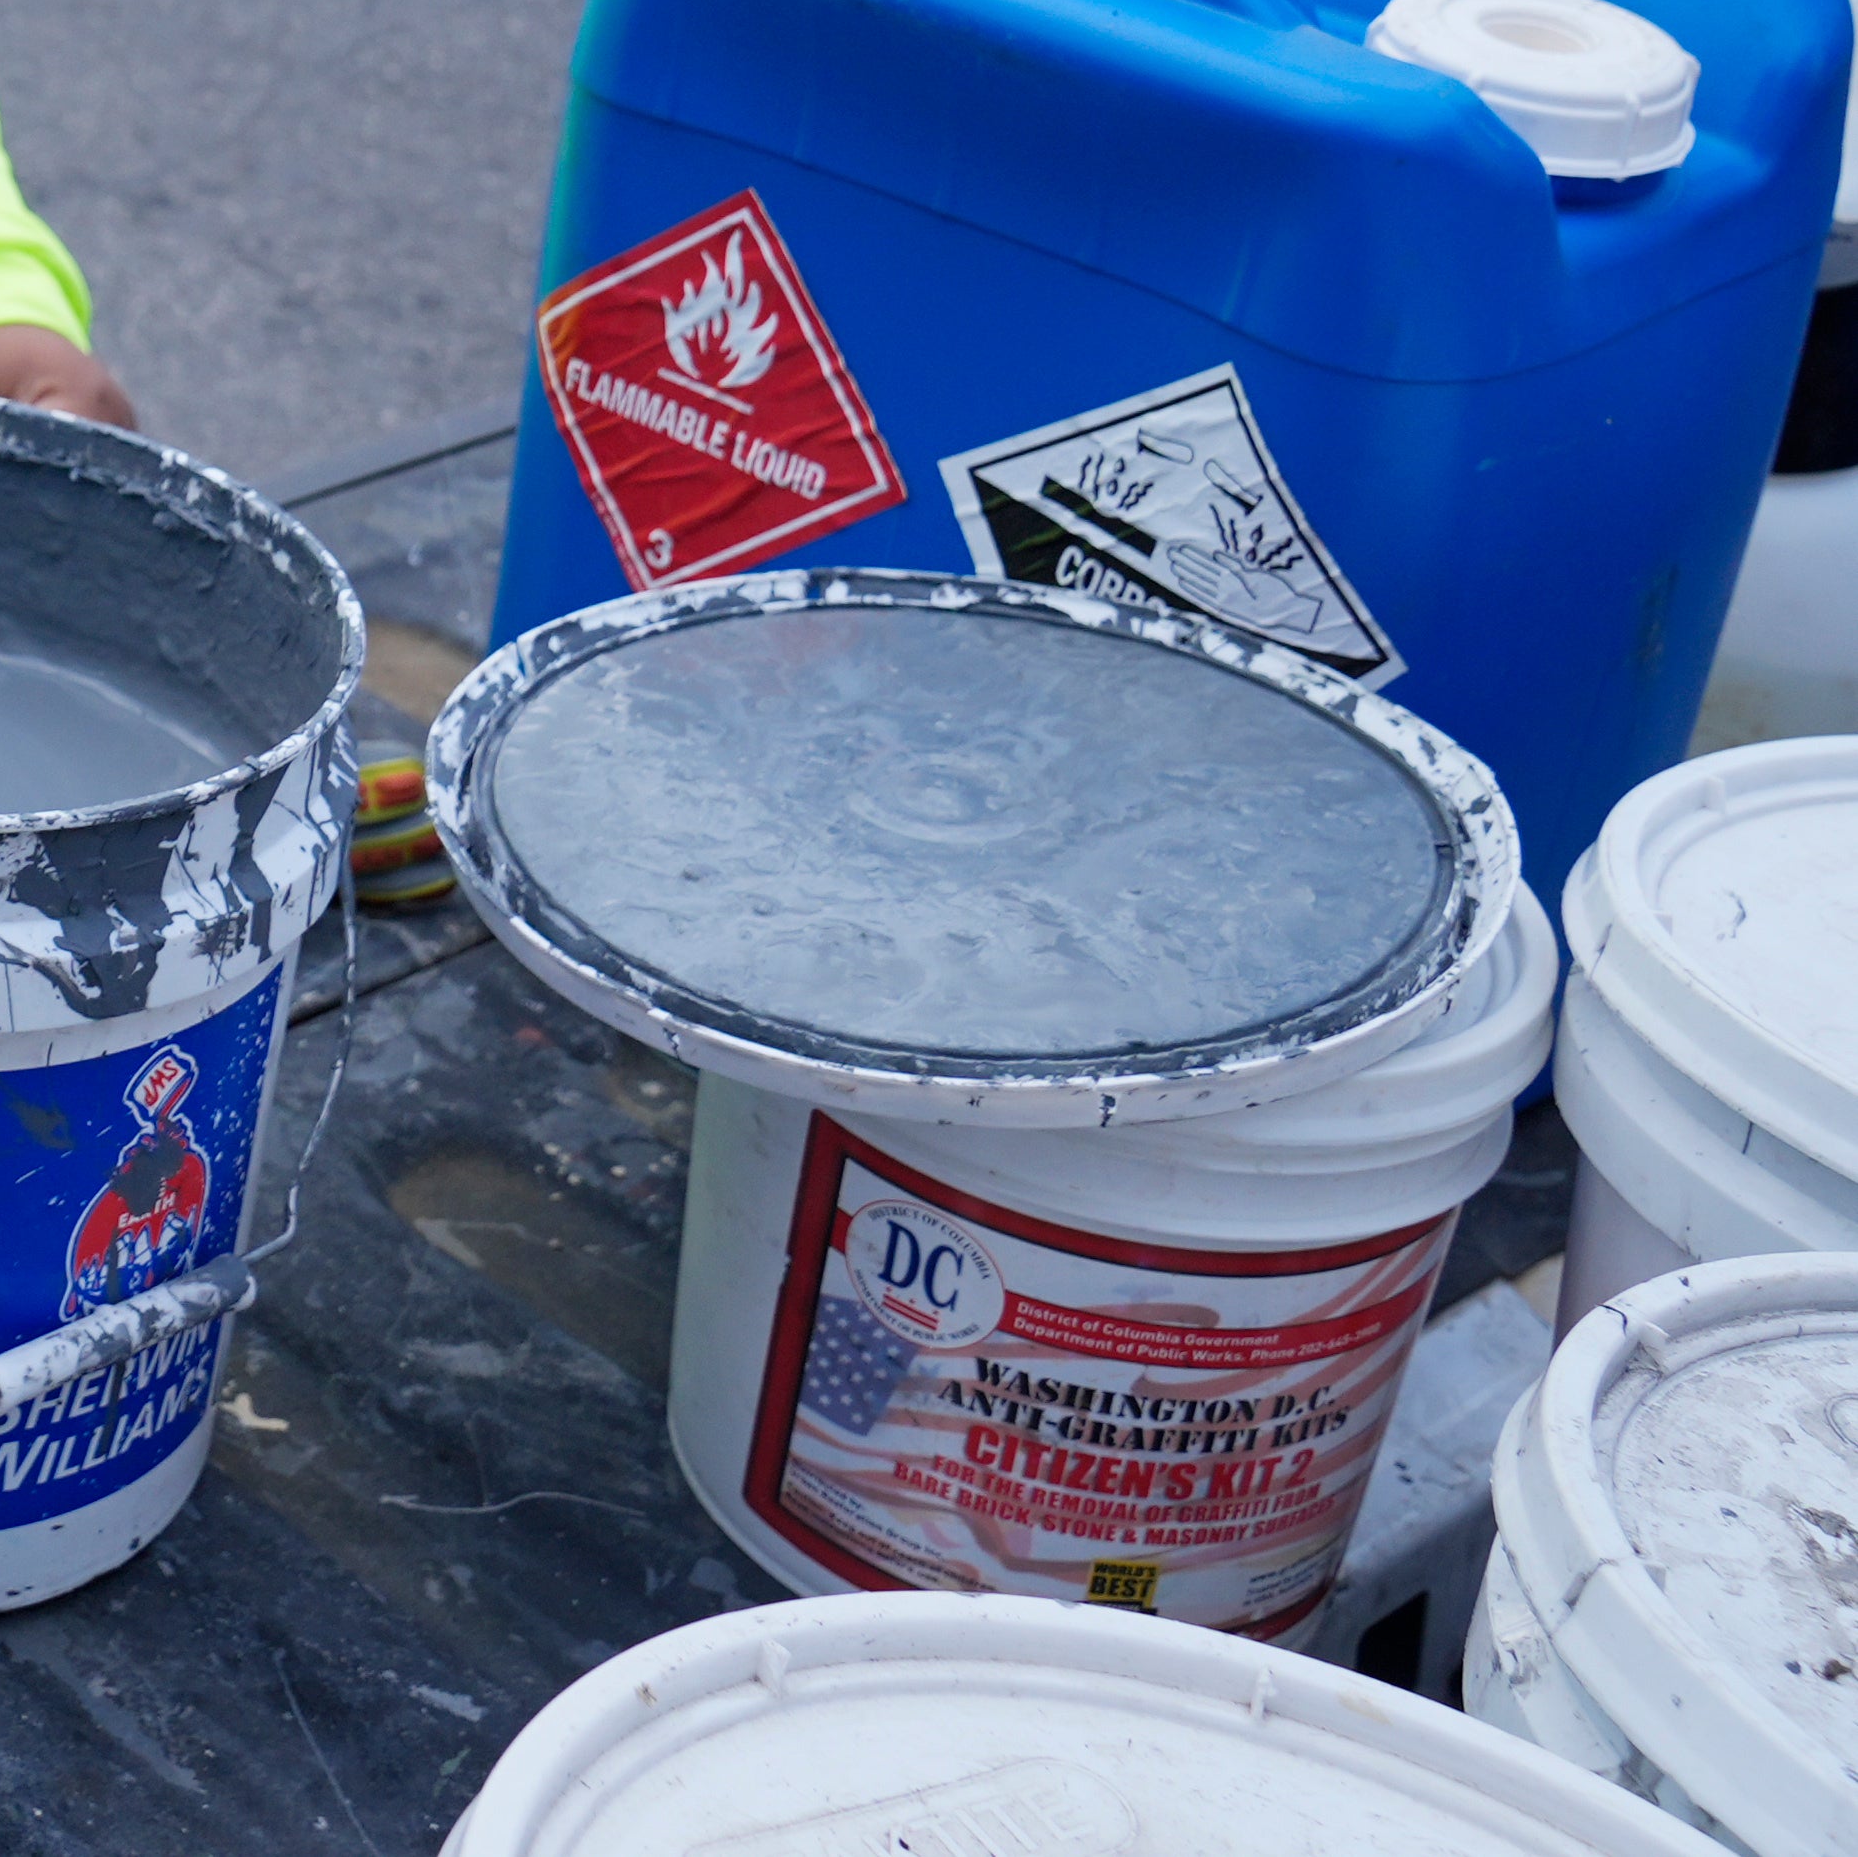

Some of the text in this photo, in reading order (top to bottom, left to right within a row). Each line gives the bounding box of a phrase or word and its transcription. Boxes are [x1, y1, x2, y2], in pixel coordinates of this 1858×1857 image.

[564, 356, 828, 501] FLAMMABLE LIQUID
[644, 527, 675, 571] 3
[142, 1059, 180, 1107] SWP
[877, 1218, 964, 1313] DC
[1013, 1316, 1113, 1353] Department
[1116, 1338, 1134, 1355] of
[1137, 1343, 1187, 1361] Public
[1249, 1346, 1295, 1361] Phone
[1016, 1300, 1280, 1347] District of Columbia Government
[937, 1379, 1350, 1454] ANTI-GRAFFITI KITS
[973, 1356, 1336, 1424] WASHINGTON D.C.
[932, 1455, 1322, 1525] FOR THE REMOVAL OF GRAFFITI FROM
[963, 1424, 1316, 1501] CITIZEN'S KIT 2
[893, 1461, 953, 1500] BARE
[955, 1488, 1035, 1528] BRICK,
[1040, 1512, 1118, 1542] STONE
[1122, 1527, 1137, 1544] &
[1141, 1523, 1251, 1546] MASONRY
[1251, 1497, 1336, 1538] SURFACES
[1089, 1576, 1156, 1597] BEST
[1093, 1563, 1157, 1578] WORLD'S
